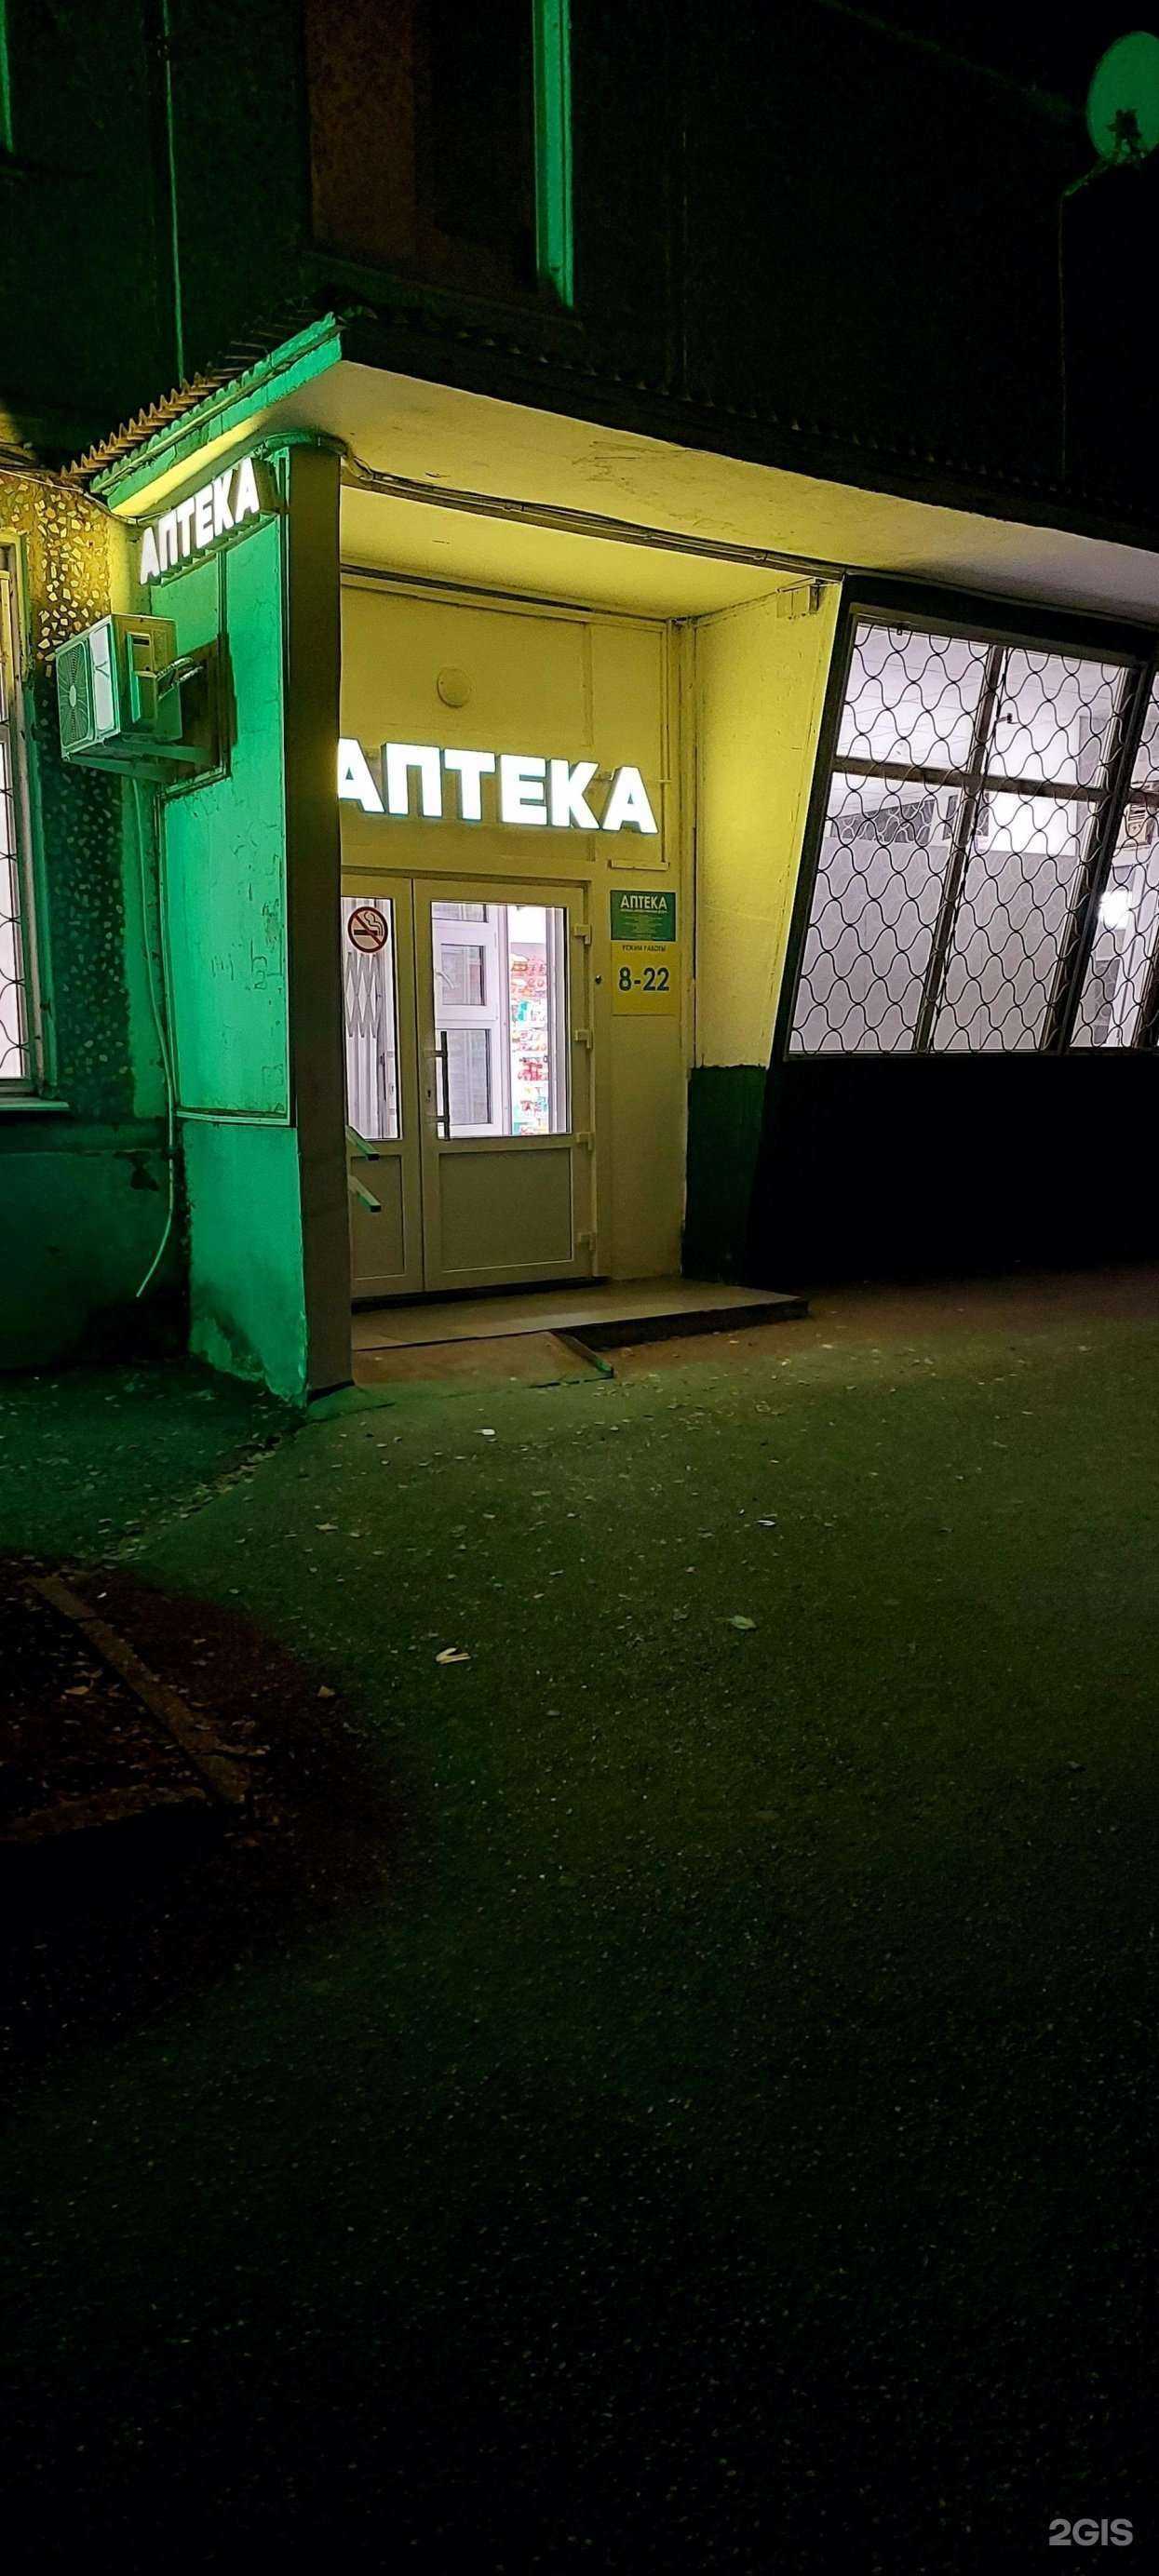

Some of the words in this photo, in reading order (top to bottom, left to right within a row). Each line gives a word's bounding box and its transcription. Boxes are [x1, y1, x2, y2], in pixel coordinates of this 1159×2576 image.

[140, 457, 260, 585] АПТЕКА
[338, 737, 659, 834] АПТЕКА
[620, 894, 667, 910] АПТЕКА
[619, 966, 670, 992] 8-22
